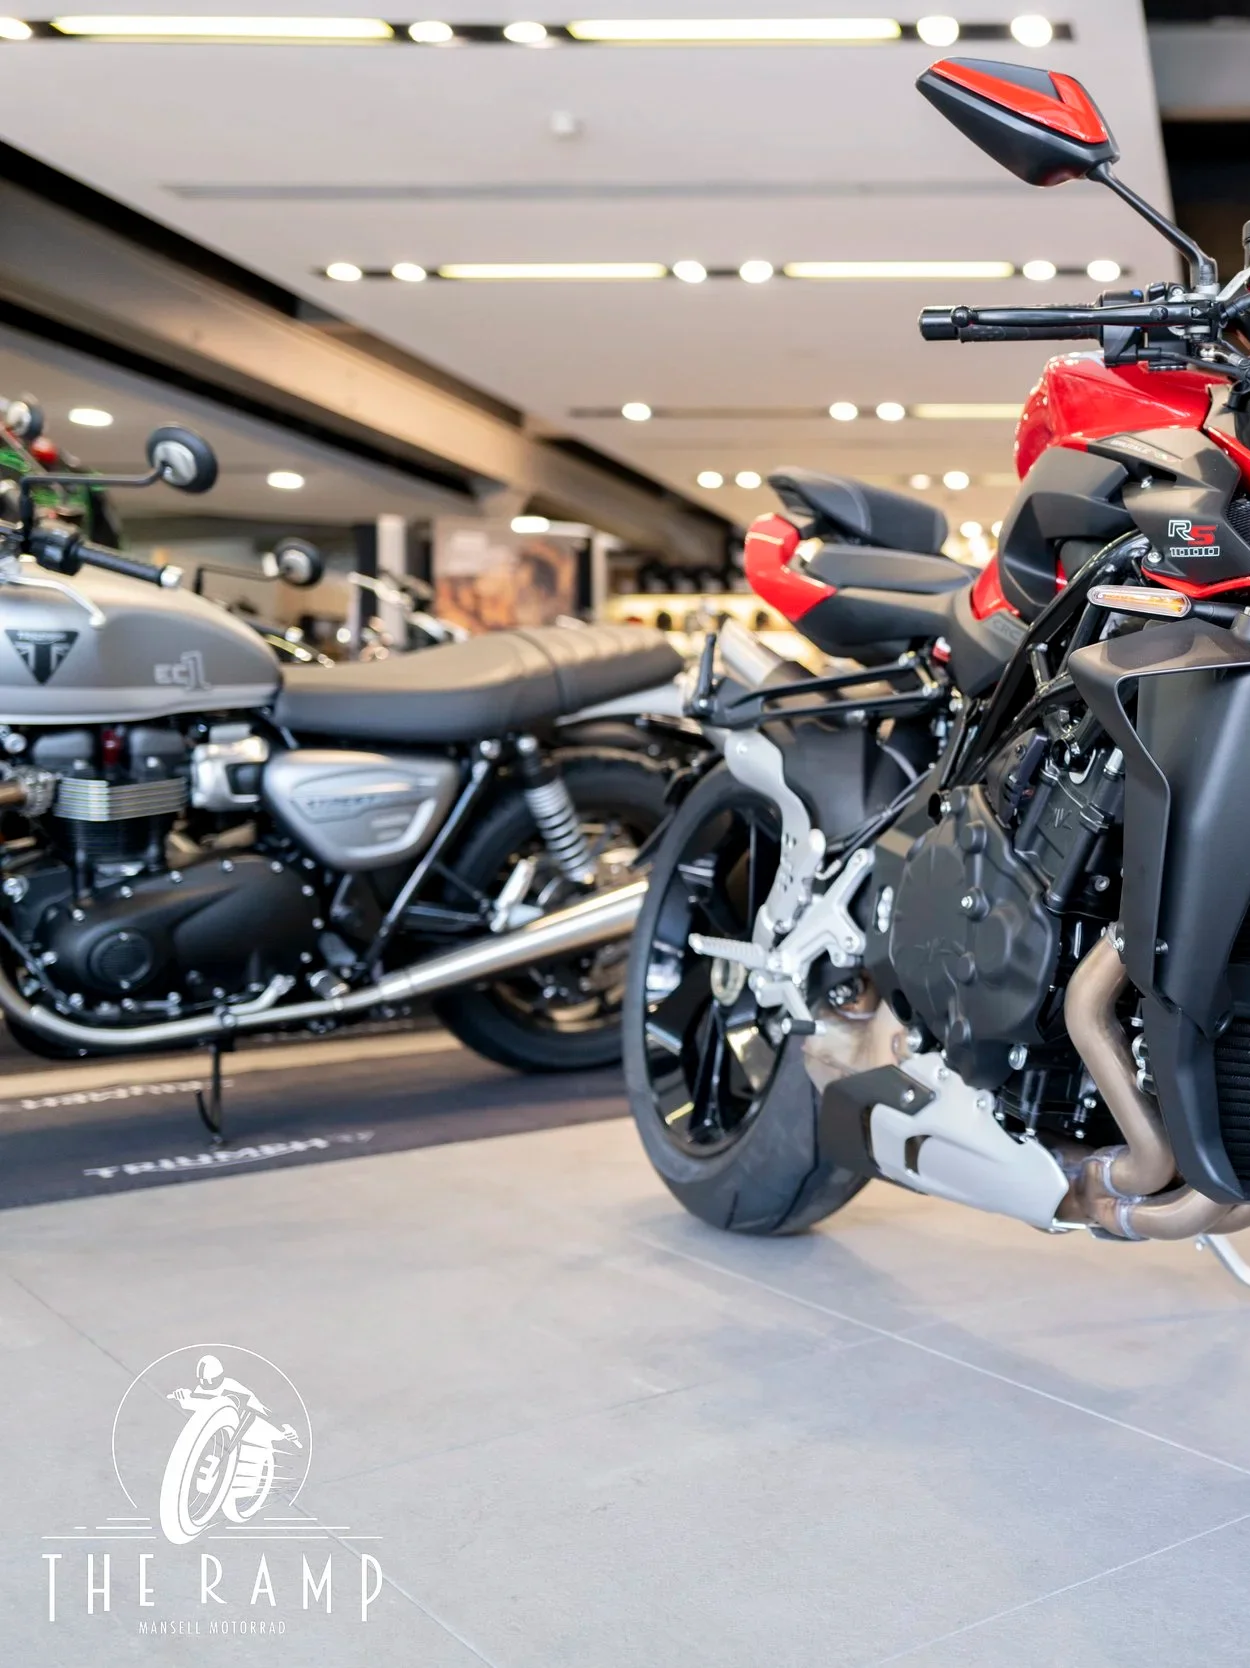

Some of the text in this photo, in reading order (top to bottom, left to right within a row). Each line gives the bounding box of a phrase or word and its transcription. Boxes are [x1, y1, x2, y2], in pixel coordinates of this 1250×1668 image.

[1168, 519, 1218, 546] RS
[1169, 545, 1220, 557] 1000
[83, 1137, 329, 1178] TRIUMPH
